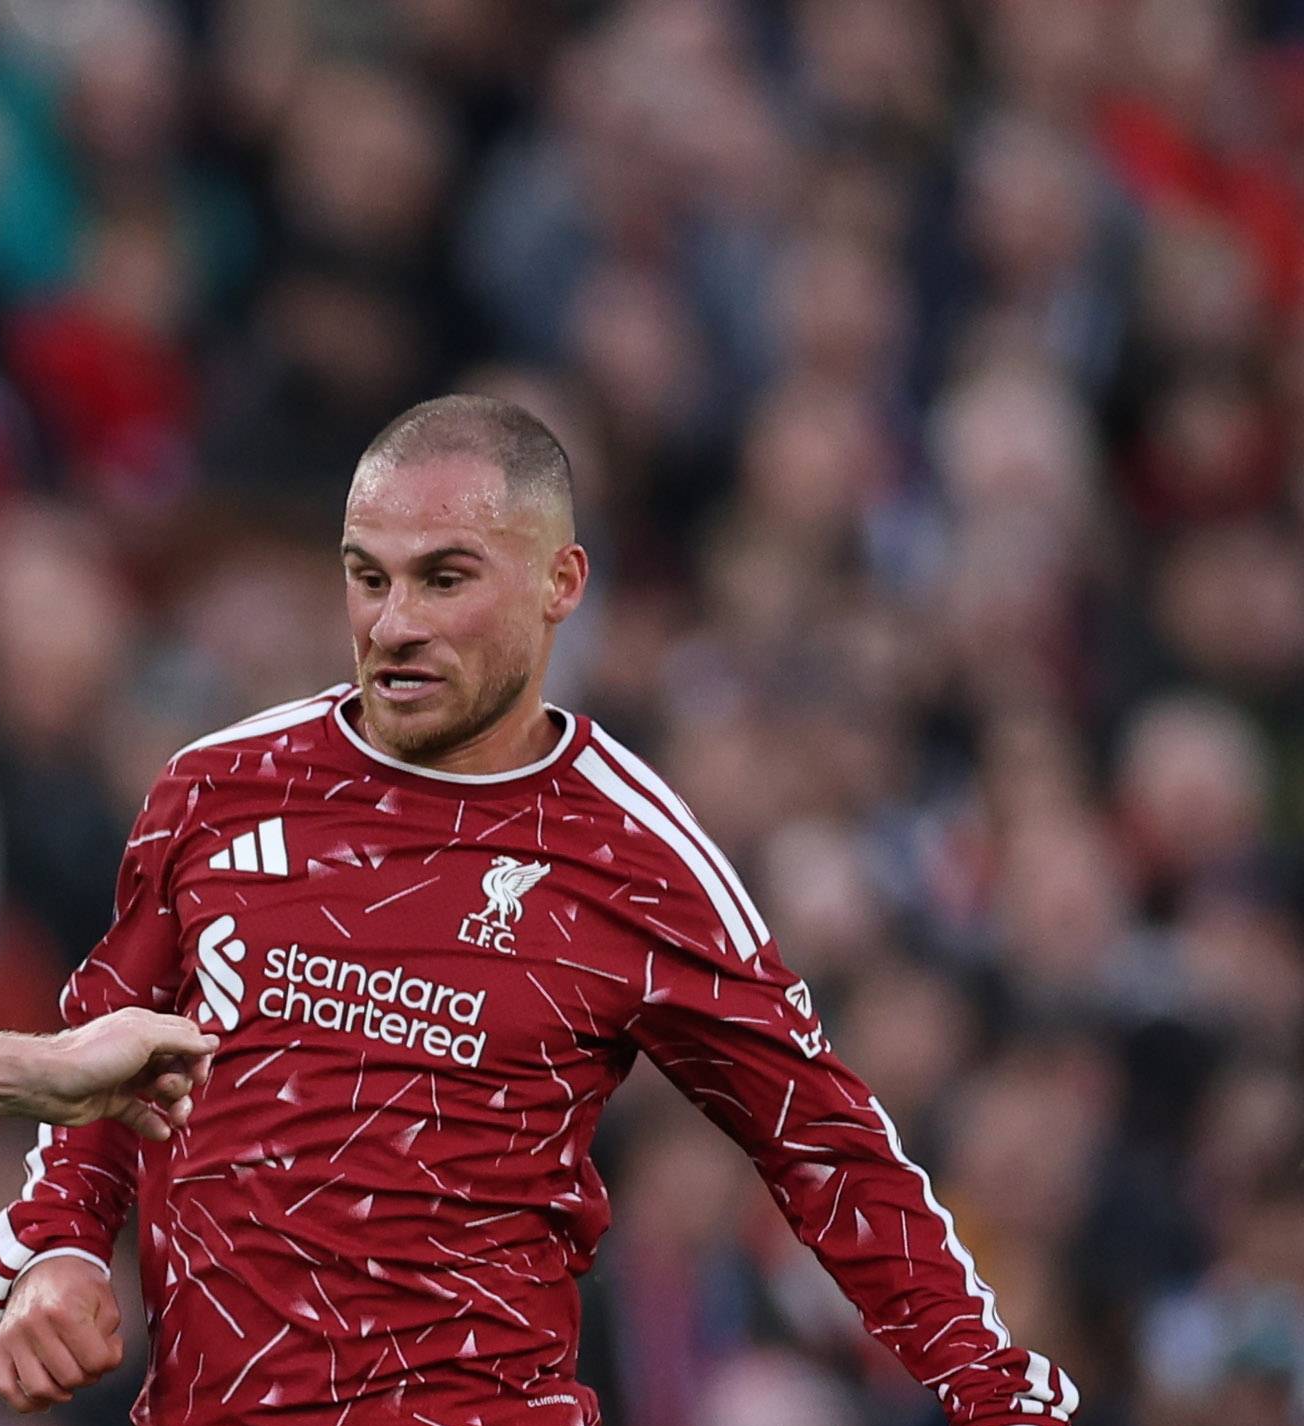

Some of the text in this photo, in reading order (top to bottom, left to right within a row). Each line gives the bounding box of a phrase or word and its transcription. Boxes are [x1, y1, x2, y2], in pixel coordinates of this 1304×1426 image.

[458, 918, 517, 956] L.F.C.
[259, 983, 486, 1068] chartered
[264, 944, 486, 1026] standard
